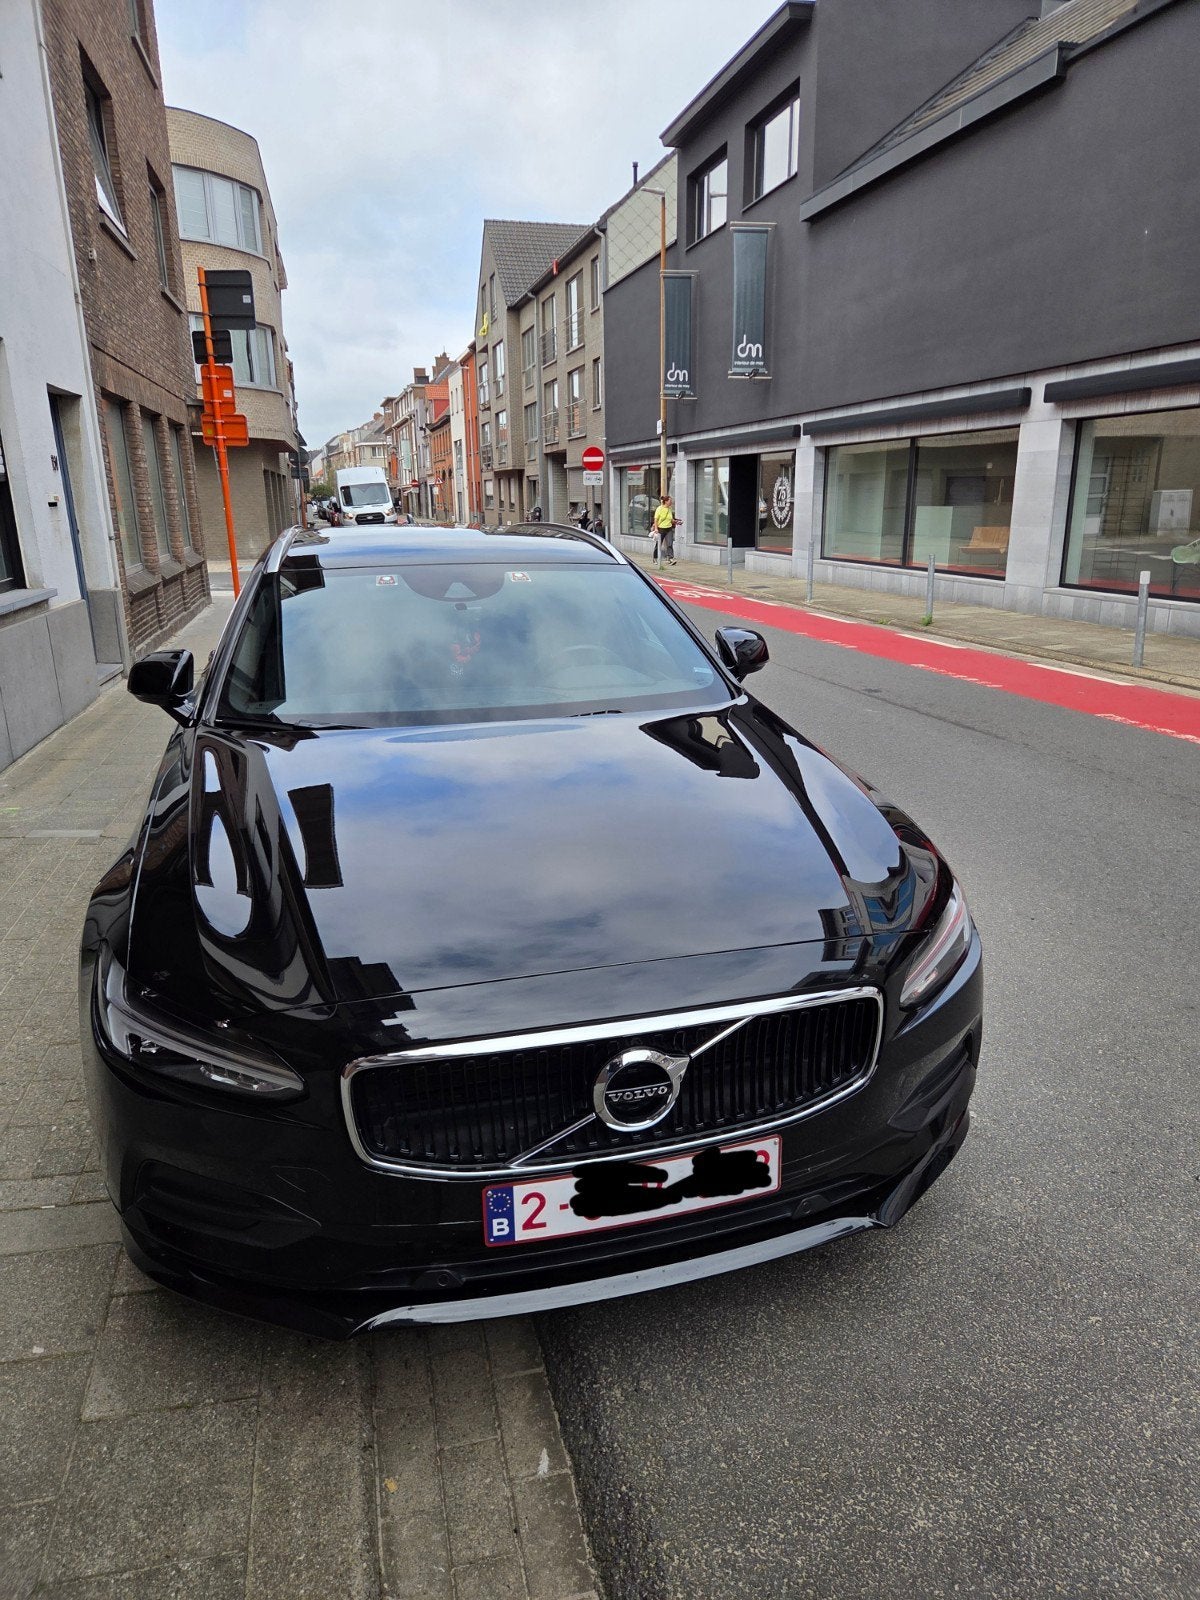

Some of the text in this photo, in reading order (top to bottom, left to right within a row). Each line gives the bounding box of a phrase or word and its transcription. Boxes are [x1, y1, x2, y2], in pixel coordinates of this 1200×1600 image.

[737, 334, 763, 358] dm
[667, 362, 689, 382] dm
[778, 486, 786, 500] 75
[608, 1086, 668, 1102] VOLVO
[492, 1217, 510, 1237] B
